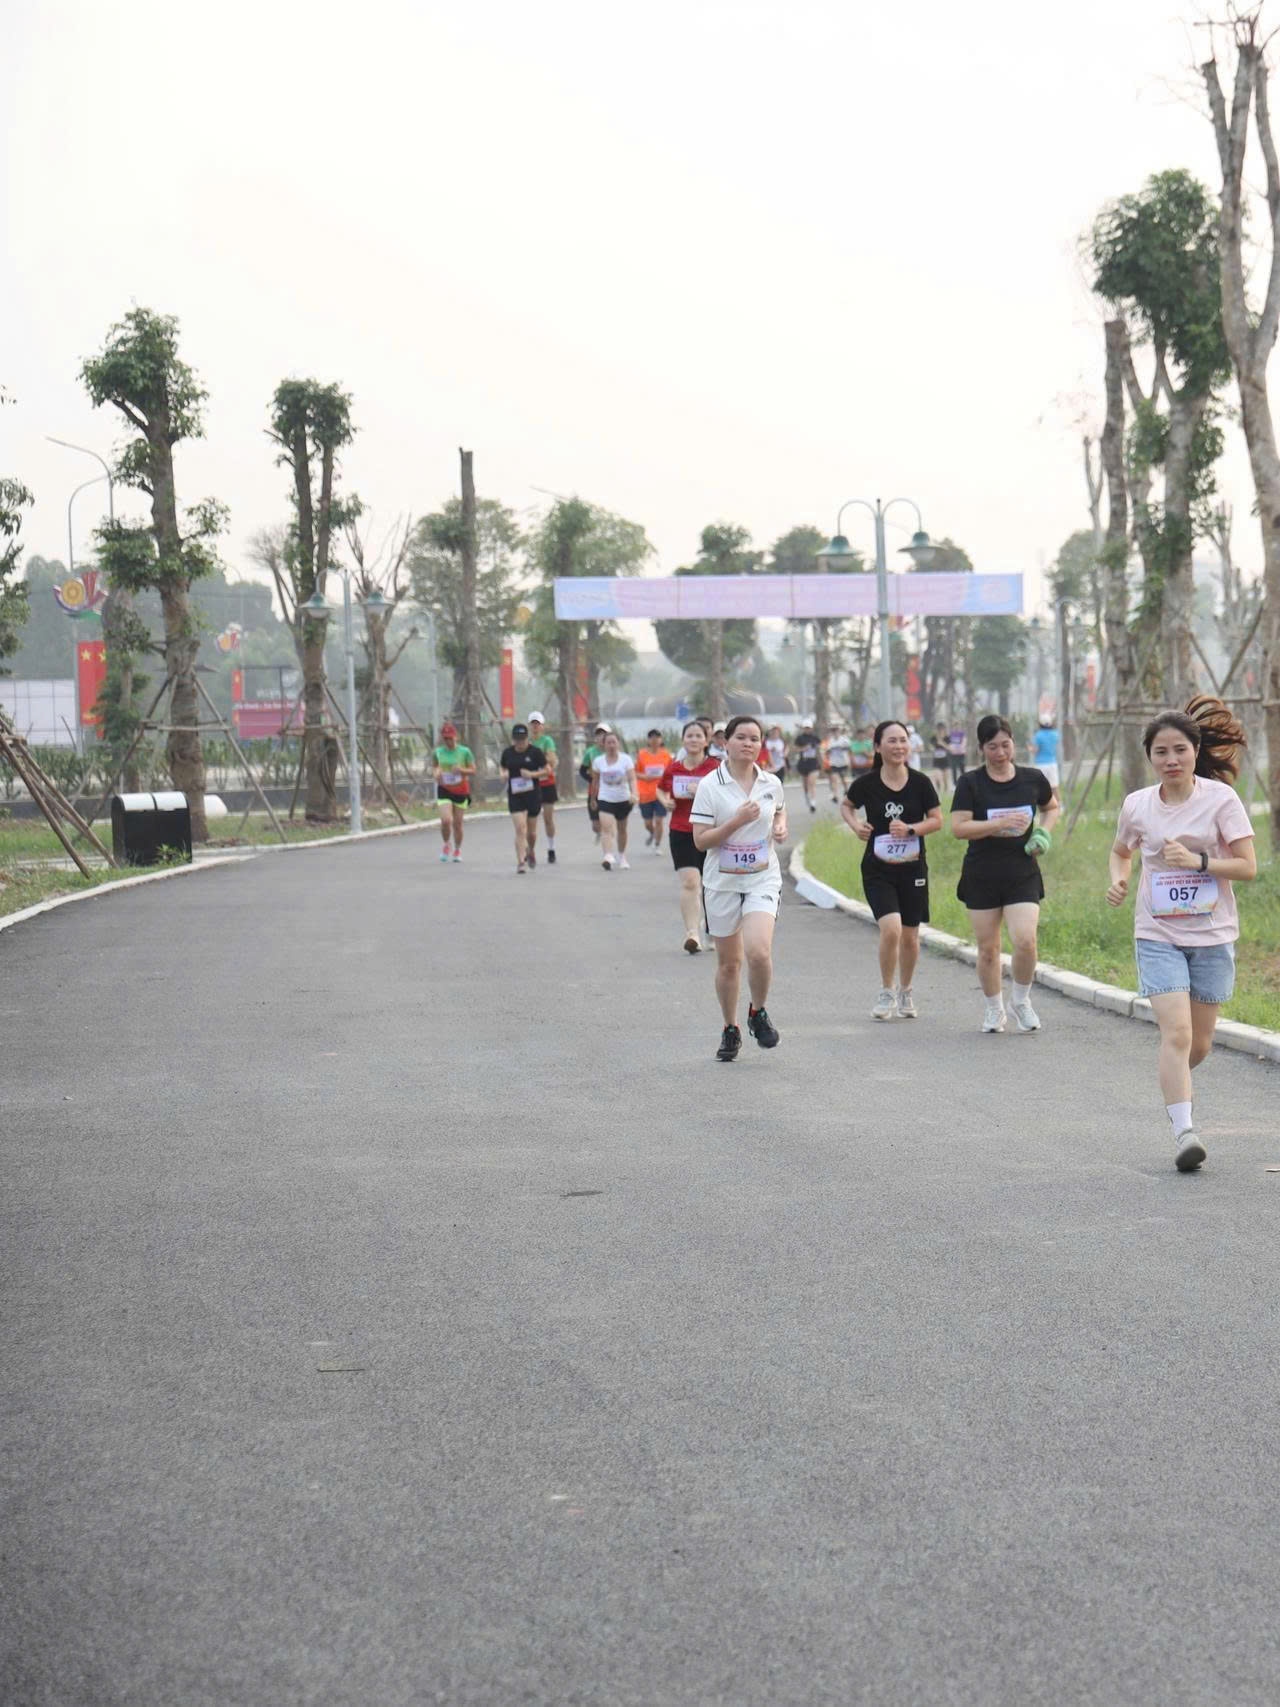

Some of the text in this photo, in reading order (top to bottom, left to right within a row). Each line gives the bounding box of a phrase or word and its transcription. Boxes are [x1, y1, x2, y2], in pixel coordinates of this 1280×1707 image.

[887, 844, 907, 854] 277
[733, 853, 756, 863] 149
[1169, 887, 1199, 901] 057
